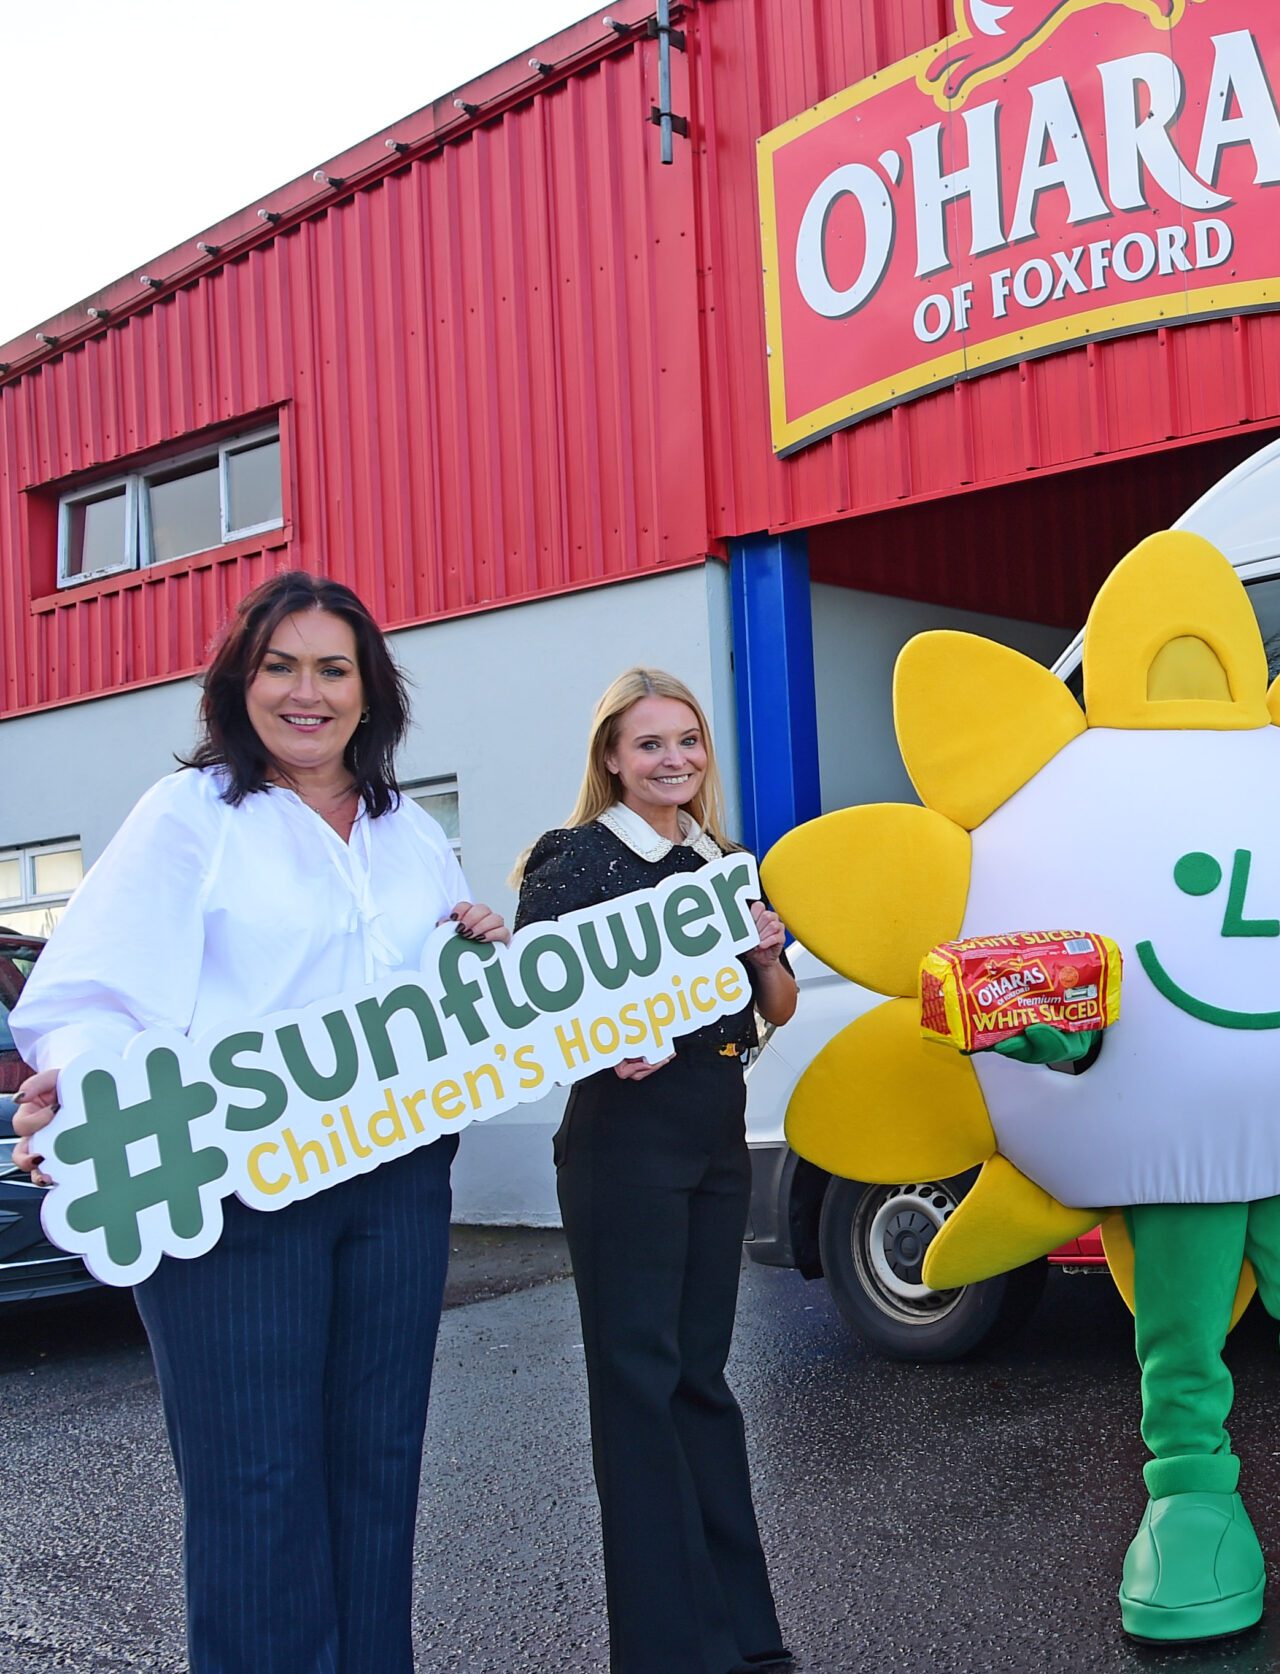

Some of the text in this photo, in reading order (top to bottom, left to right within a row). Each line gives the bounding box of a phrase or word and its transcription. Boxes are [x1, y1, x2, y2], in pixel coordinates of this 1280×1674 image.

[912, 218, 1234, 343] OF FOXFORD
[973, 1000, 1098, 1032] WHITE SLICED
[977, 967, 1046, 1007] O'HARAS
[1018, 994, 1061, 1008] Premium
[54, 861, 752, 1266] #sunflower
[247, 965, 744, 1195] Children's Hospice
